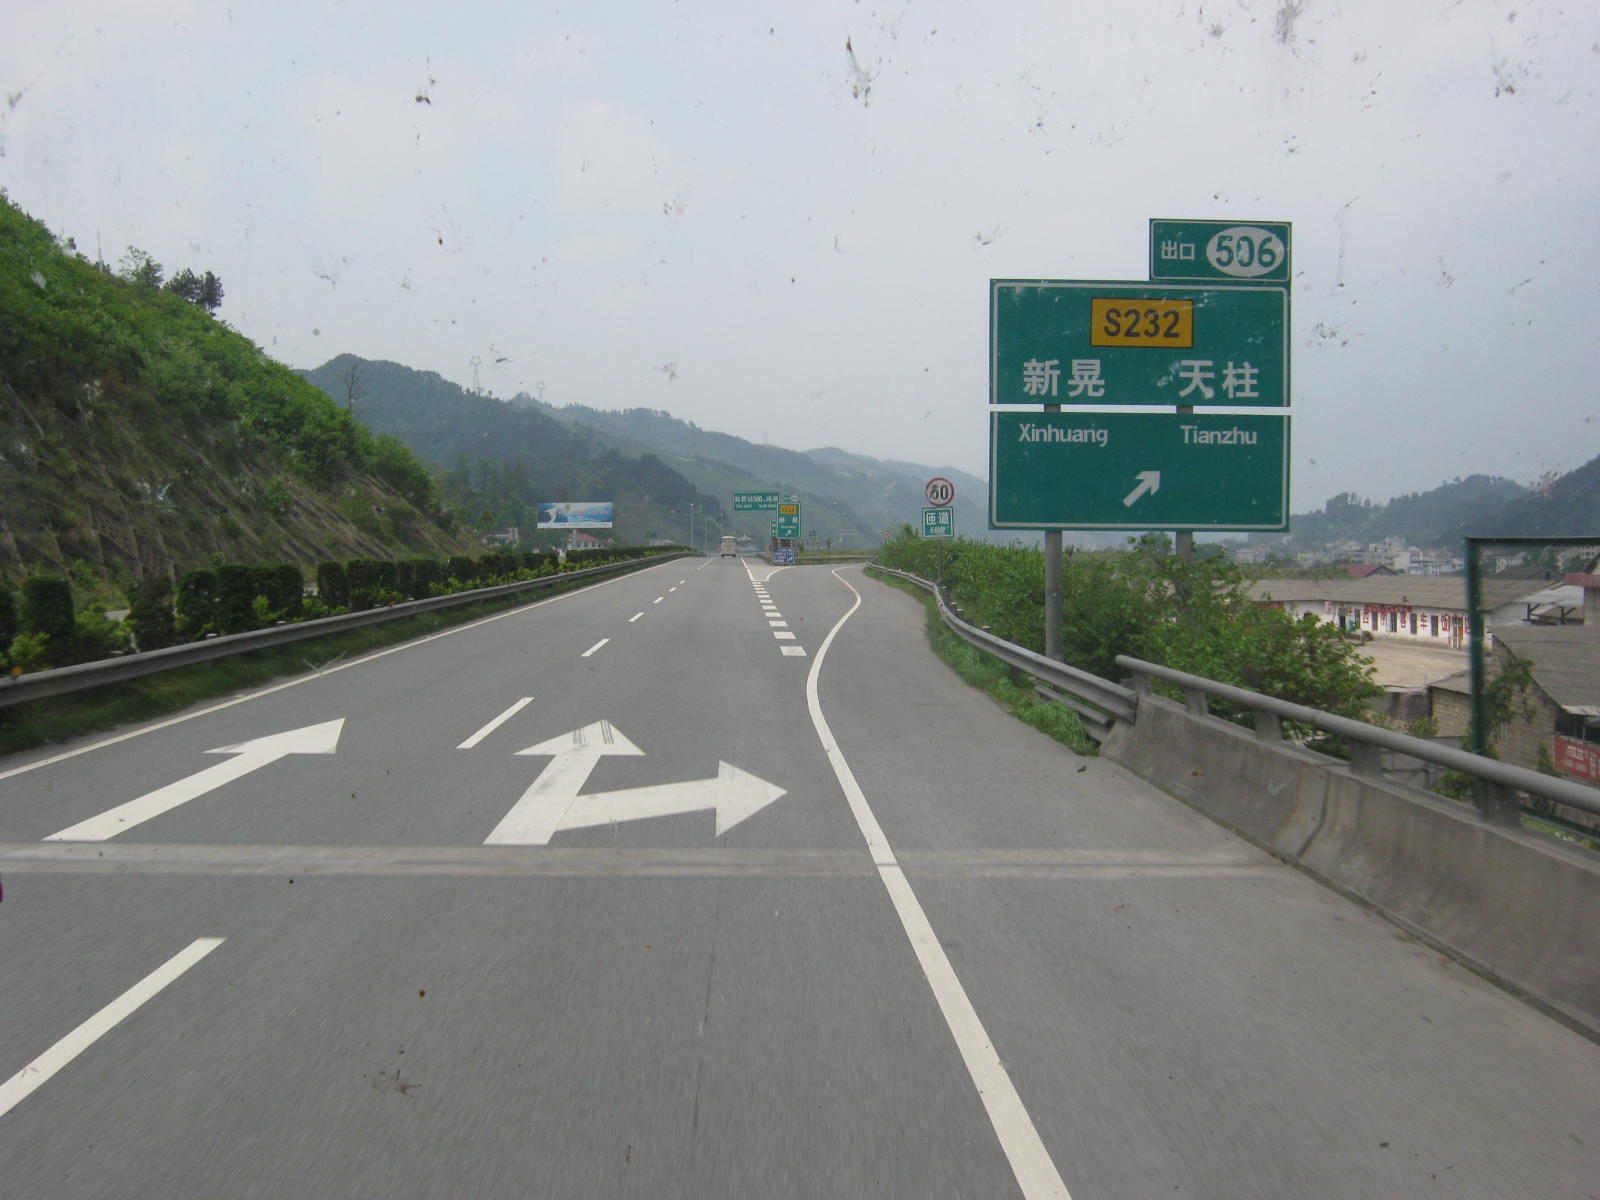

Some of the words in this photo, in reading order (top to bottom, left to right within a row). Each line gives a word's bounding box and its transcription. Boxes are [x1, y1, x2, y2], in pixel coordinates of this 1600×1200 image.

[1160, 240, 1195, 260] 出口
[1214, 235, 1277, 268] 506
[1103, 308, 1180, 339] S232
[1022, 358, 1106, 397] 新晃
[1178, 359, 1260, 399] 天柱
[1019, 423, 1109, 448] Xinhuang
[1180, 425, 1259, 446] Tianzhu
